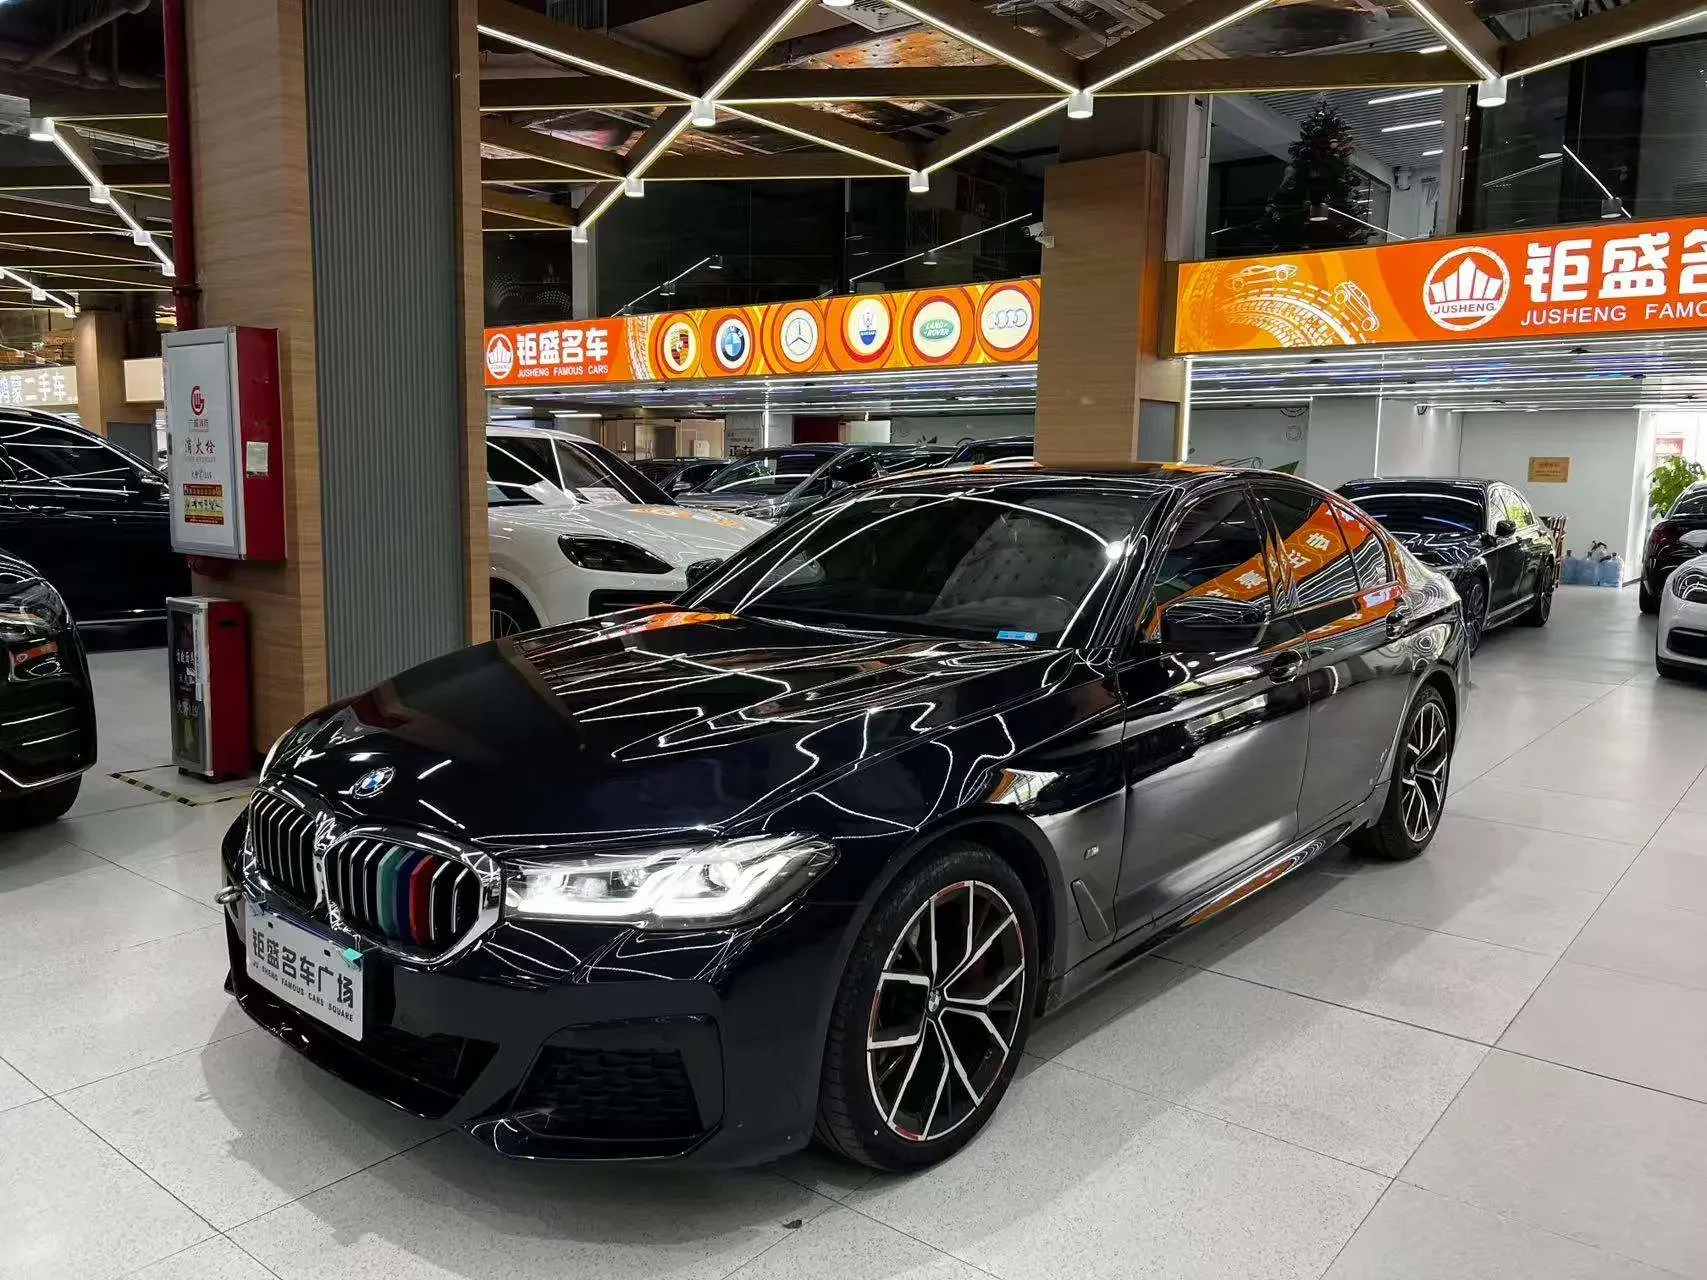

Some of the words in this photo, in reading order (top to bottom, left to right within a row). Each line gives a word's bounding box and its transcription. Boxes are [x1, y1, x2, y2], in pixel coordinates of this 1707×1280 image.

[1433, 302, 1496, 315] JUSHENG
[1520, 305, 1627, 326] JUSHENG
[925, 321, 944, 330] LAND
[926, 328, 950, 337] ROVER
[516, 327, 608, 365] 钜盛名车
[517, 367, 549, 378] JUSHENG
[553, 366, 583, 376] FAMOUS
[587, 364, 608, 375] CARS
[252, 927, 354, 1009] 钜盛名车广场
[281, 977, 305, 996] FAMOUS
[308, 992, 324, 1007] CARS
[327, 1003, 354, 1023] SQUARE
